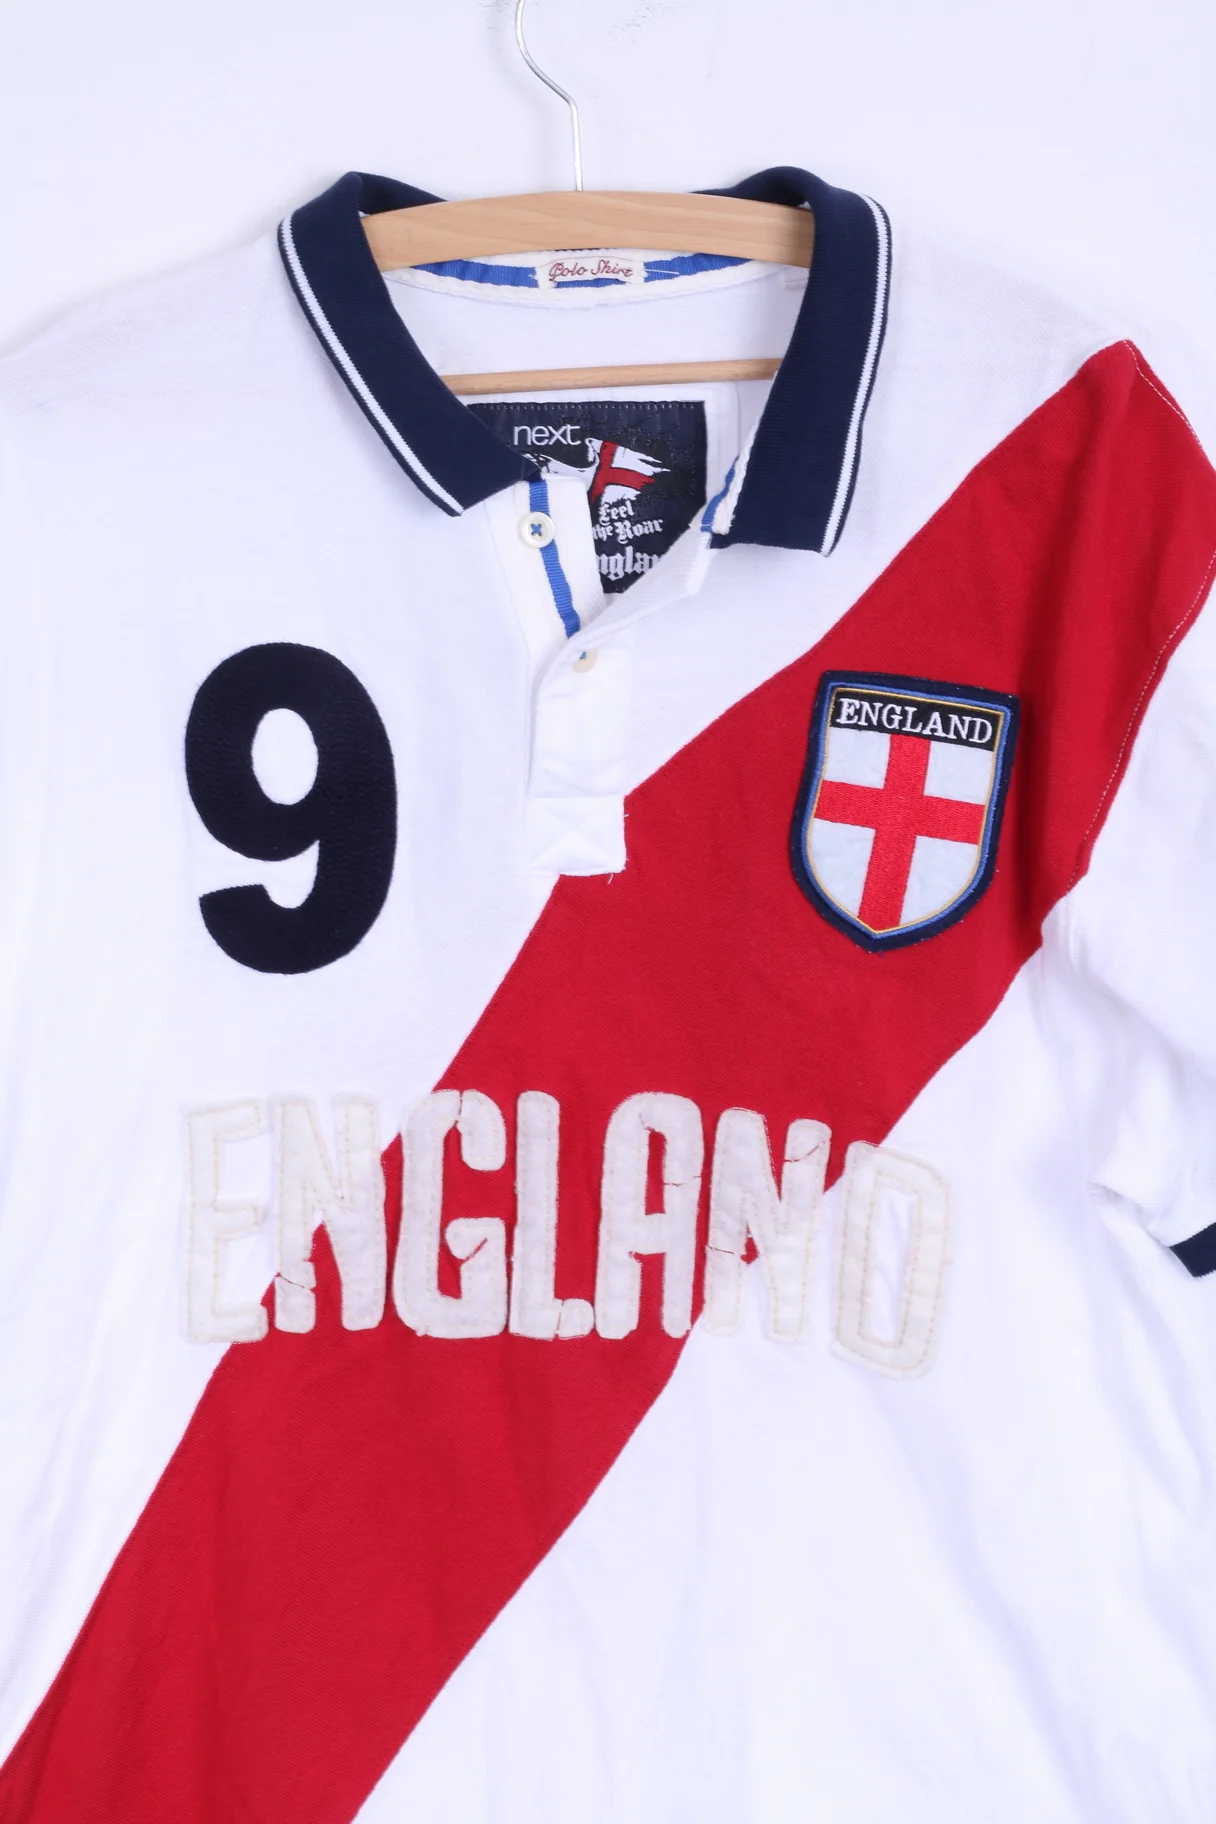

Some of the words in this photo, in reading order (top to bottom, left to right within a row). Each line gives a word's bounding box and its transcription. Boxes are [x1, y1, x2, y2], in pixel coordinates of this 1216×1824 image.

[549, 262, 588, 281] Polo
[591, 259, 633, 277] Shirt
[513, 424, 582, 446] next
[599, 500, 635, 526] Feel
[613, 519, 664, 544] Roar
[836, 698, 993, 744] ENGLAND
[185, 642, 397, 974] 9
[181, 1089, 953, 1381] ENGLAND
